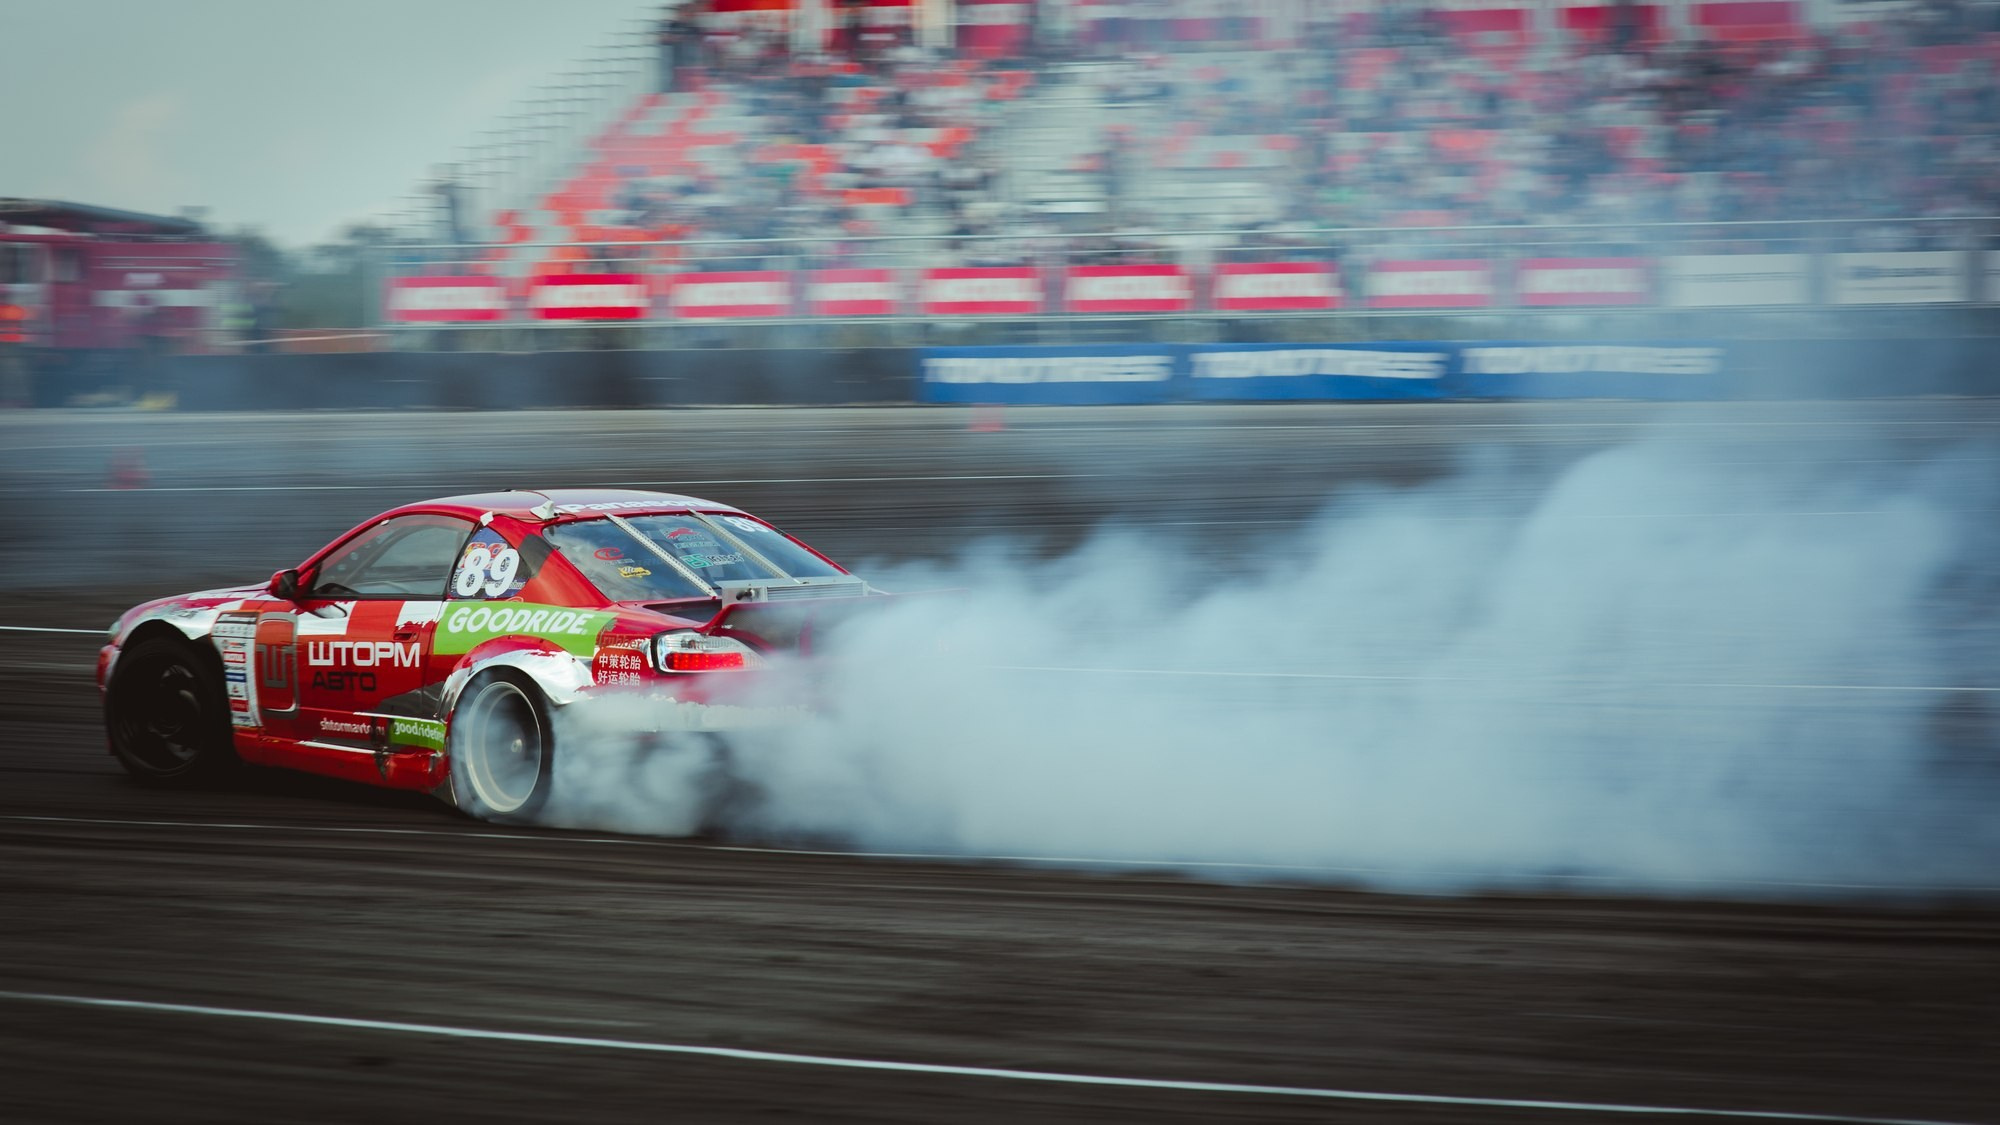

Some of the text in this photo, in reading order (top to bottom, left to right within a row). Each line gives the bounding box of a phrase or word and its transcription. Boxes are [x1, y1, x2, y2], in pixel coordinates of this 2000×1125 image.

[724, 516, 769, 532] 89
[457, 547, 520, 597] 89
[448, 606, 595, 634] GOODRIDE
[308, 641, 421, 668] ШТОРМ
[598, 653, 641, 670] 中策轮胎
[312, 671, 377, 692] АВТО
[597, 669, 641, 687] 好运轮胎
